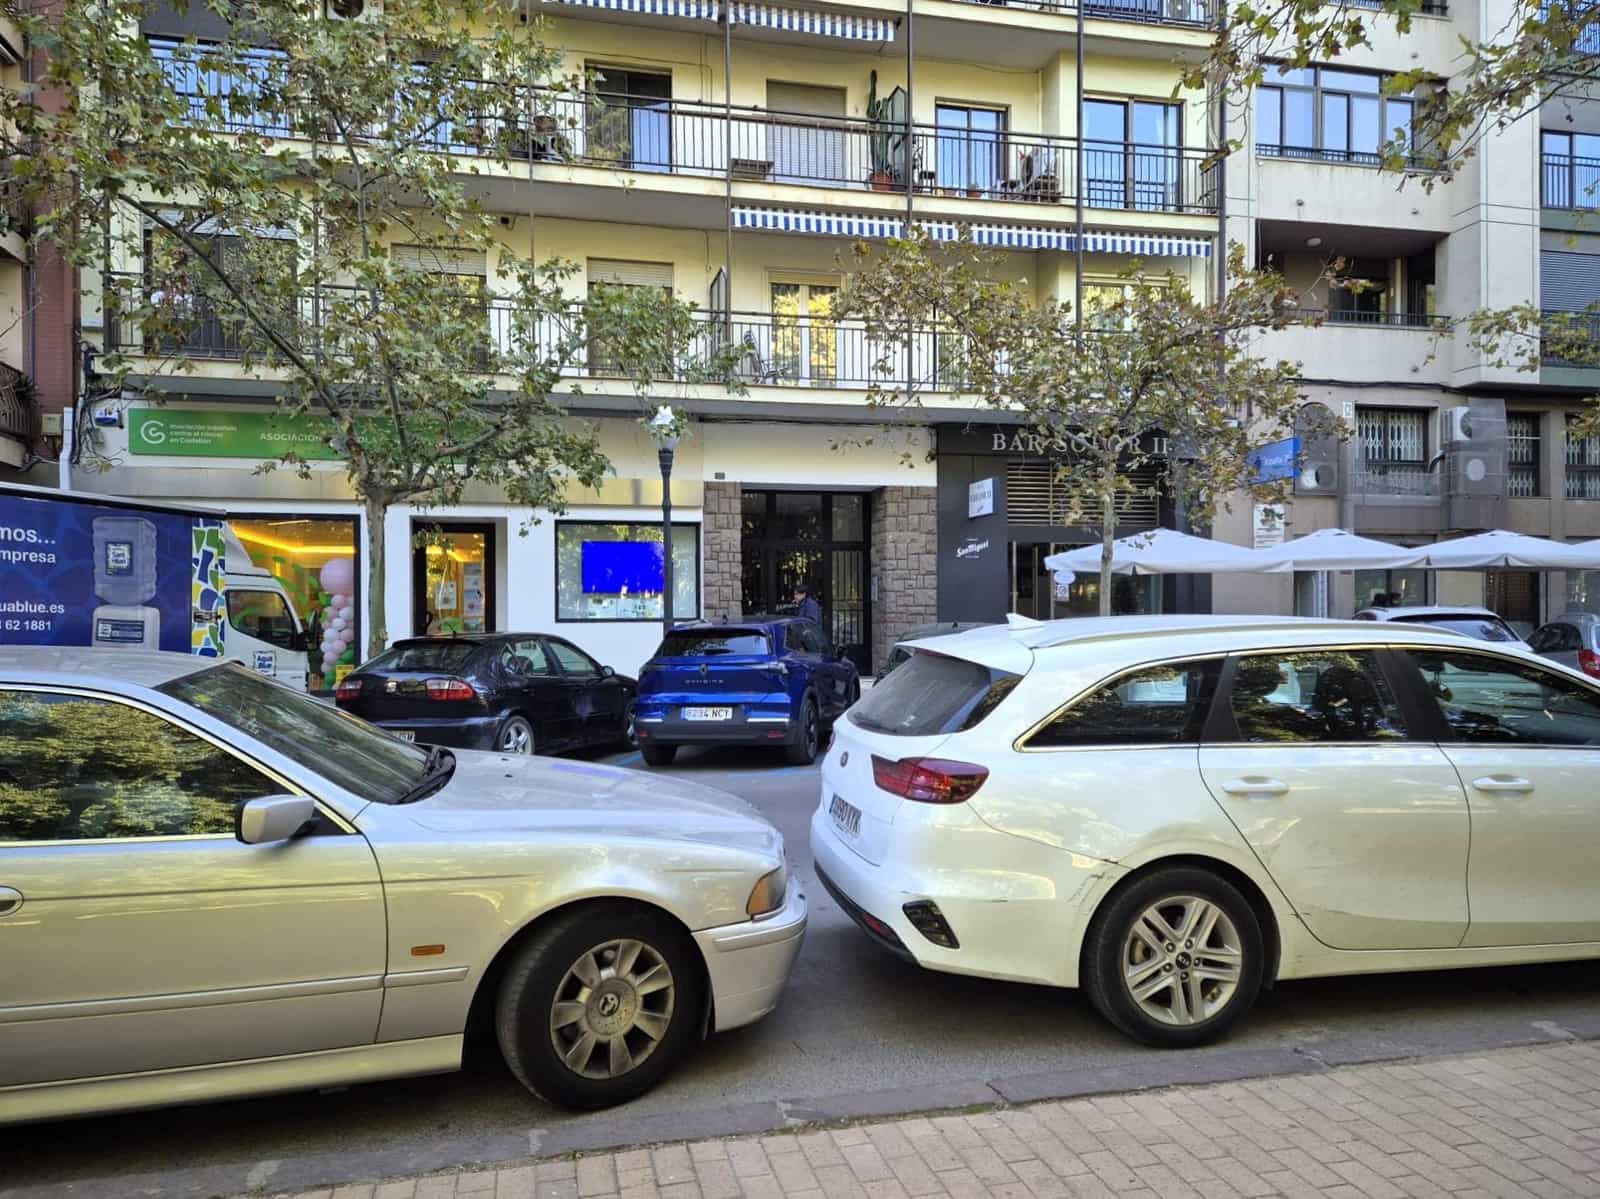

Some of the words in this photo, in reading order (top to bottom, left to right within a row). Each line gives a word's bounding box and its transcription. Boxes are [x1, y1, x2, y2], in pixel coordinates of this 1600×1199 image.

[992, 433, 1040, 451] BAR
[5, 619, 21, 631] 62
[24, 619, 52, 632] 1881
